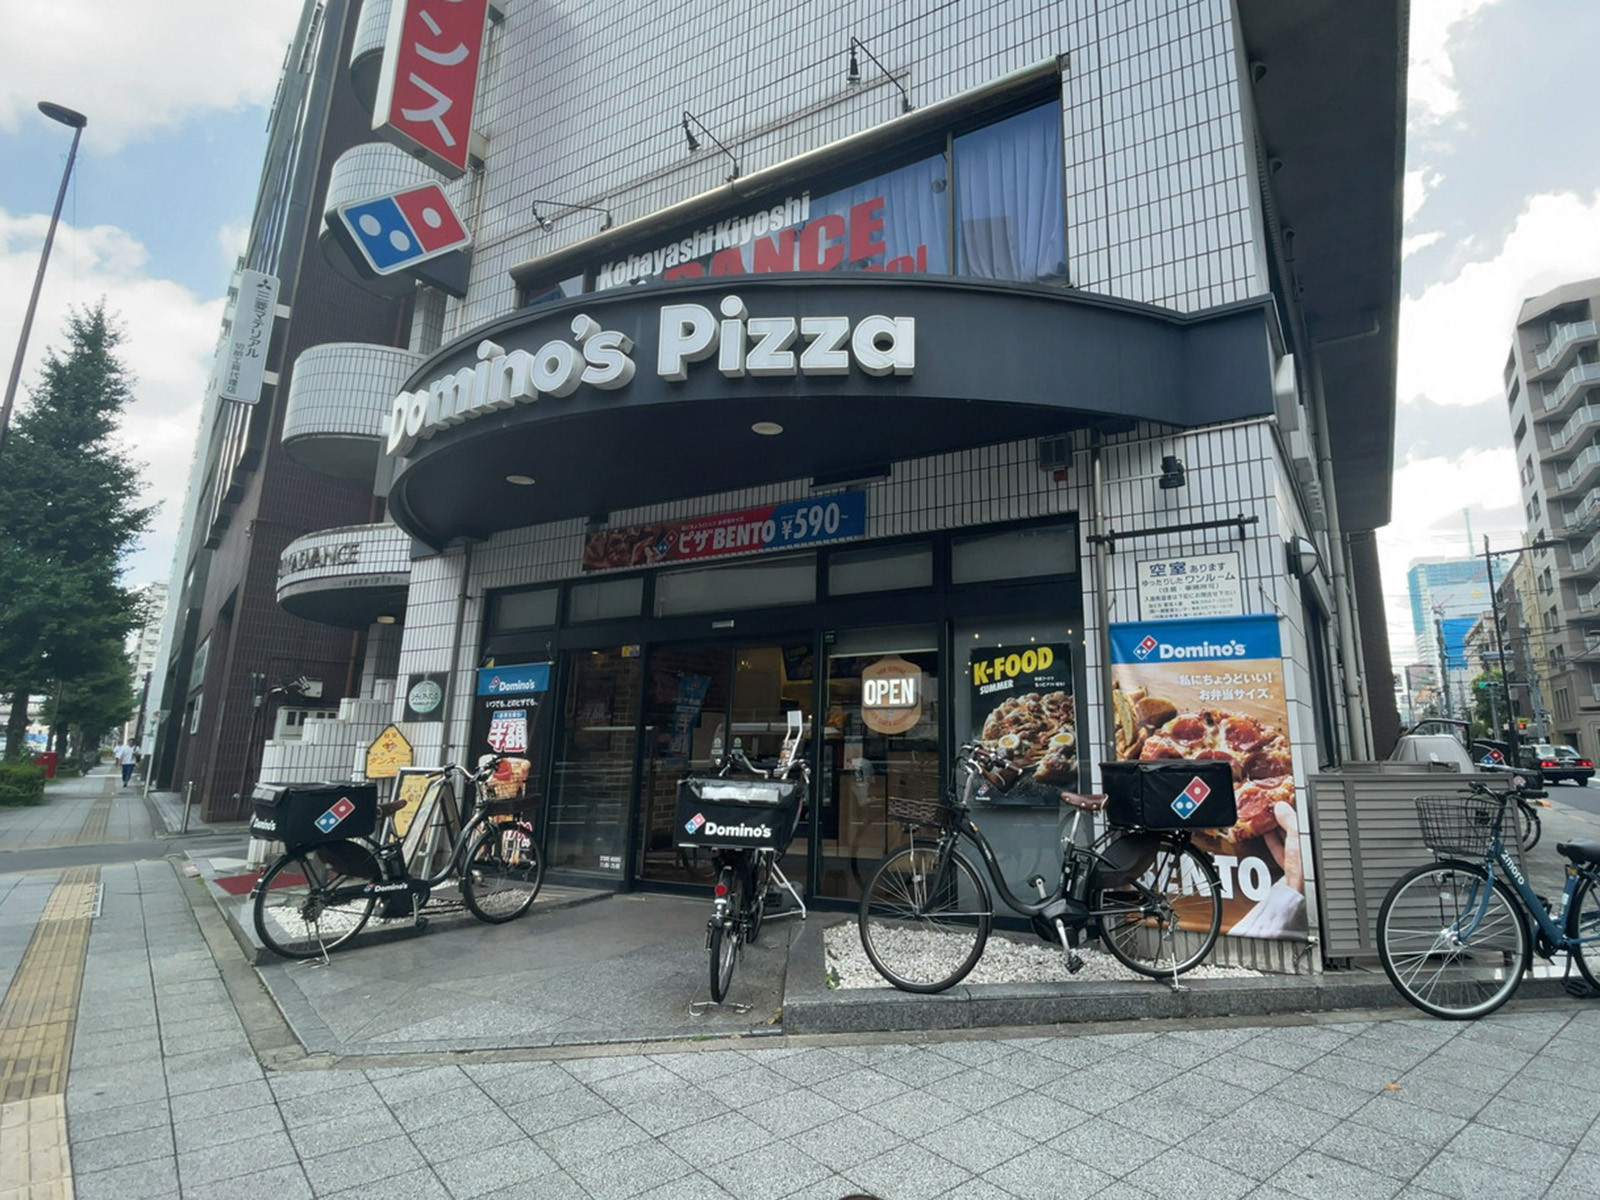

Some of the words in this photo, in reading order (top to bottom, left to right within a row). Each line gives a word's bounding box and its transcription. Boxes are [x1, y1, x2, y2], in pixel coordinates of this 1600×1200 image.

[401, 0, 469, 147] ンス
[657, 294, 915, 381] Pizza
[1159, 640, 1246, 659] Domino's
[973, 646, 1054, 686] K-FOOD
[499, 680, 536, 692] Domino's
[863, 678, 915, 705] OPEN
[979, 679, 1014, 695] SUMMER
[487, 720, 527, 753] 半額
[704, 822, 772, 838] Domino's
[374, 882, 408, 892] Domino's
